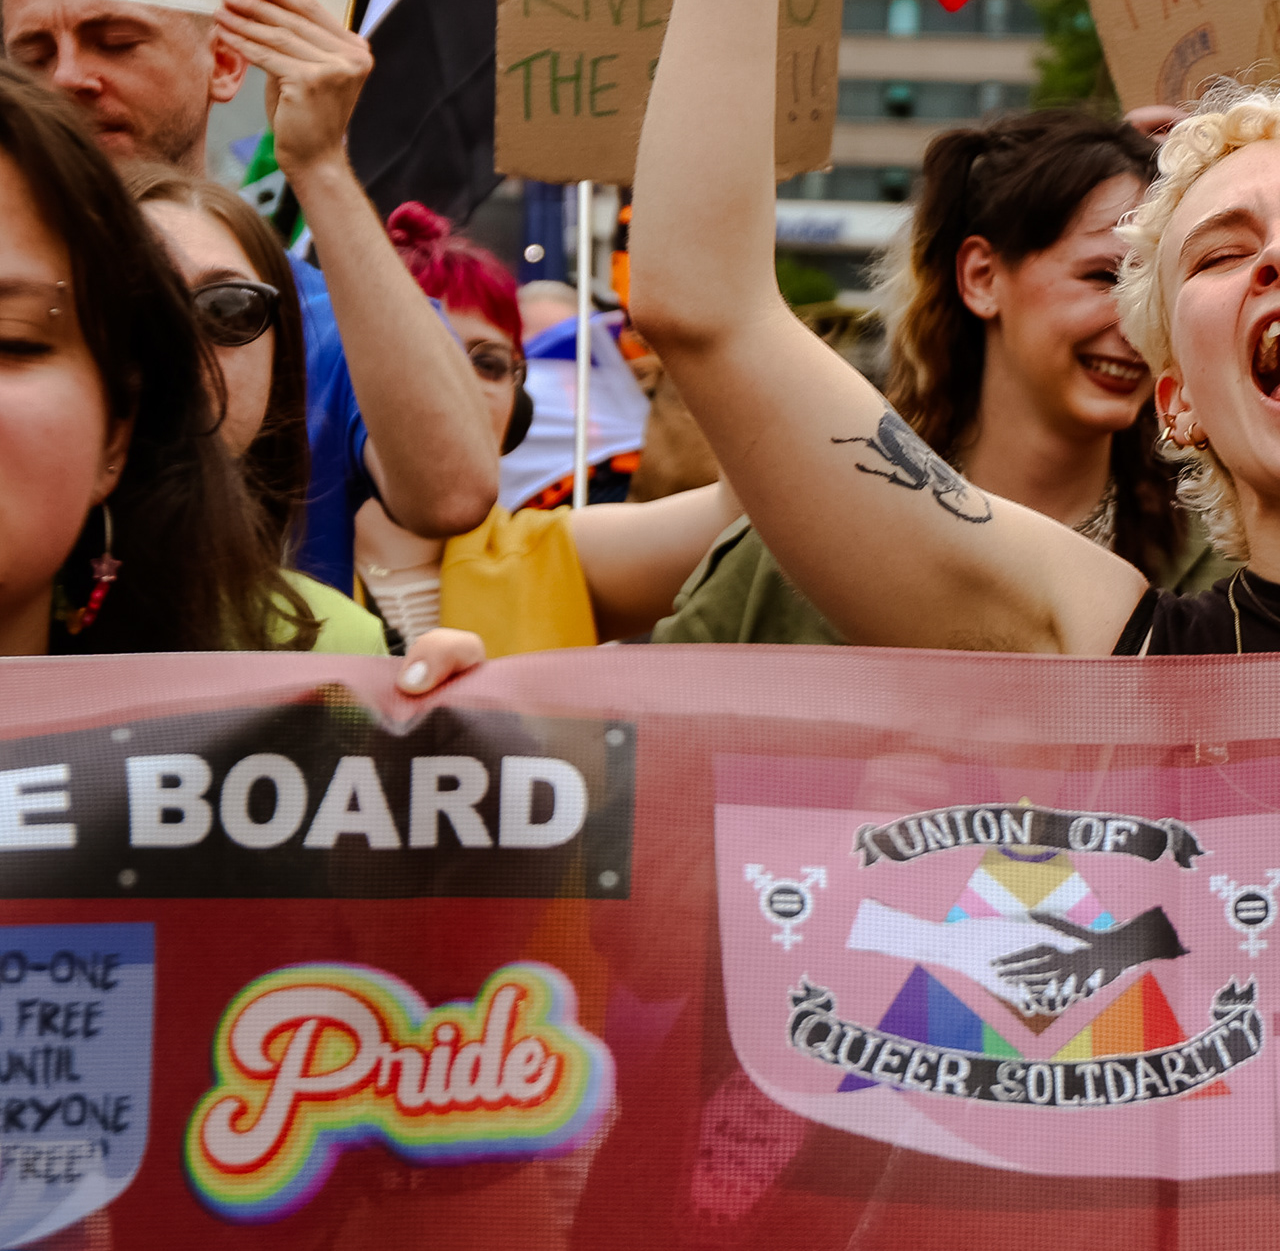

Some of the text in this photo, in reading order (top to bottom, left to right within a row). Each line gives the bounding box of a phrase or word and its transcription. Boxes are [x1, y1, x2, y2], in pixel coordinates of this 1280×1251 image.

[505, 49, 619, 121] THE
[125, 752, 589, 851] BOARD
[891, 808, 1140, 857] UNION OF
[16, 1000, 103, 1038] FREE
[794, 1007, 1264, 1106] QUEER SOLIDARITY
[201, 982, 564, 1176] Pride
